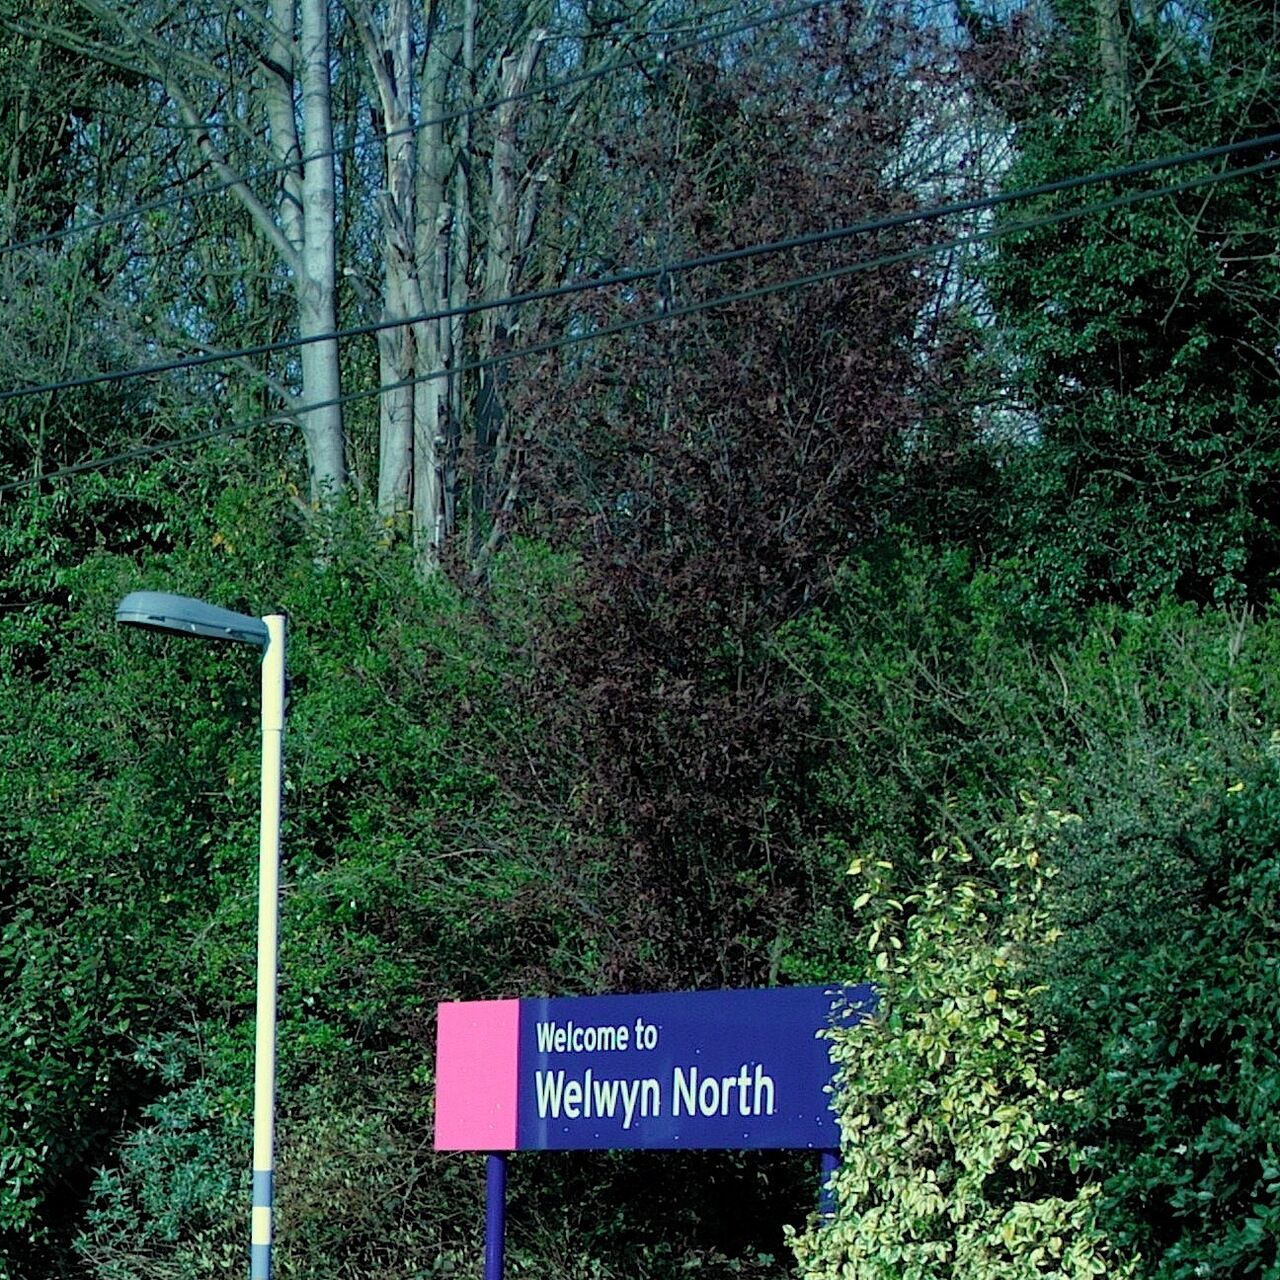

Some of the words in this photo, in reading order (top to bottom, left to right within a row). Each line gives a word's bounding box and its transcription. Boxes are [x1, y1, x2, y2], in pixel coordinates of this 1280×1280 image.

[536, 1021, 629, 1053] Welcome
[635, 1018, 658, 1051] to
[535, 1068, 661, 1129] Welwyn
[671, 1063, 775, 1117] North
